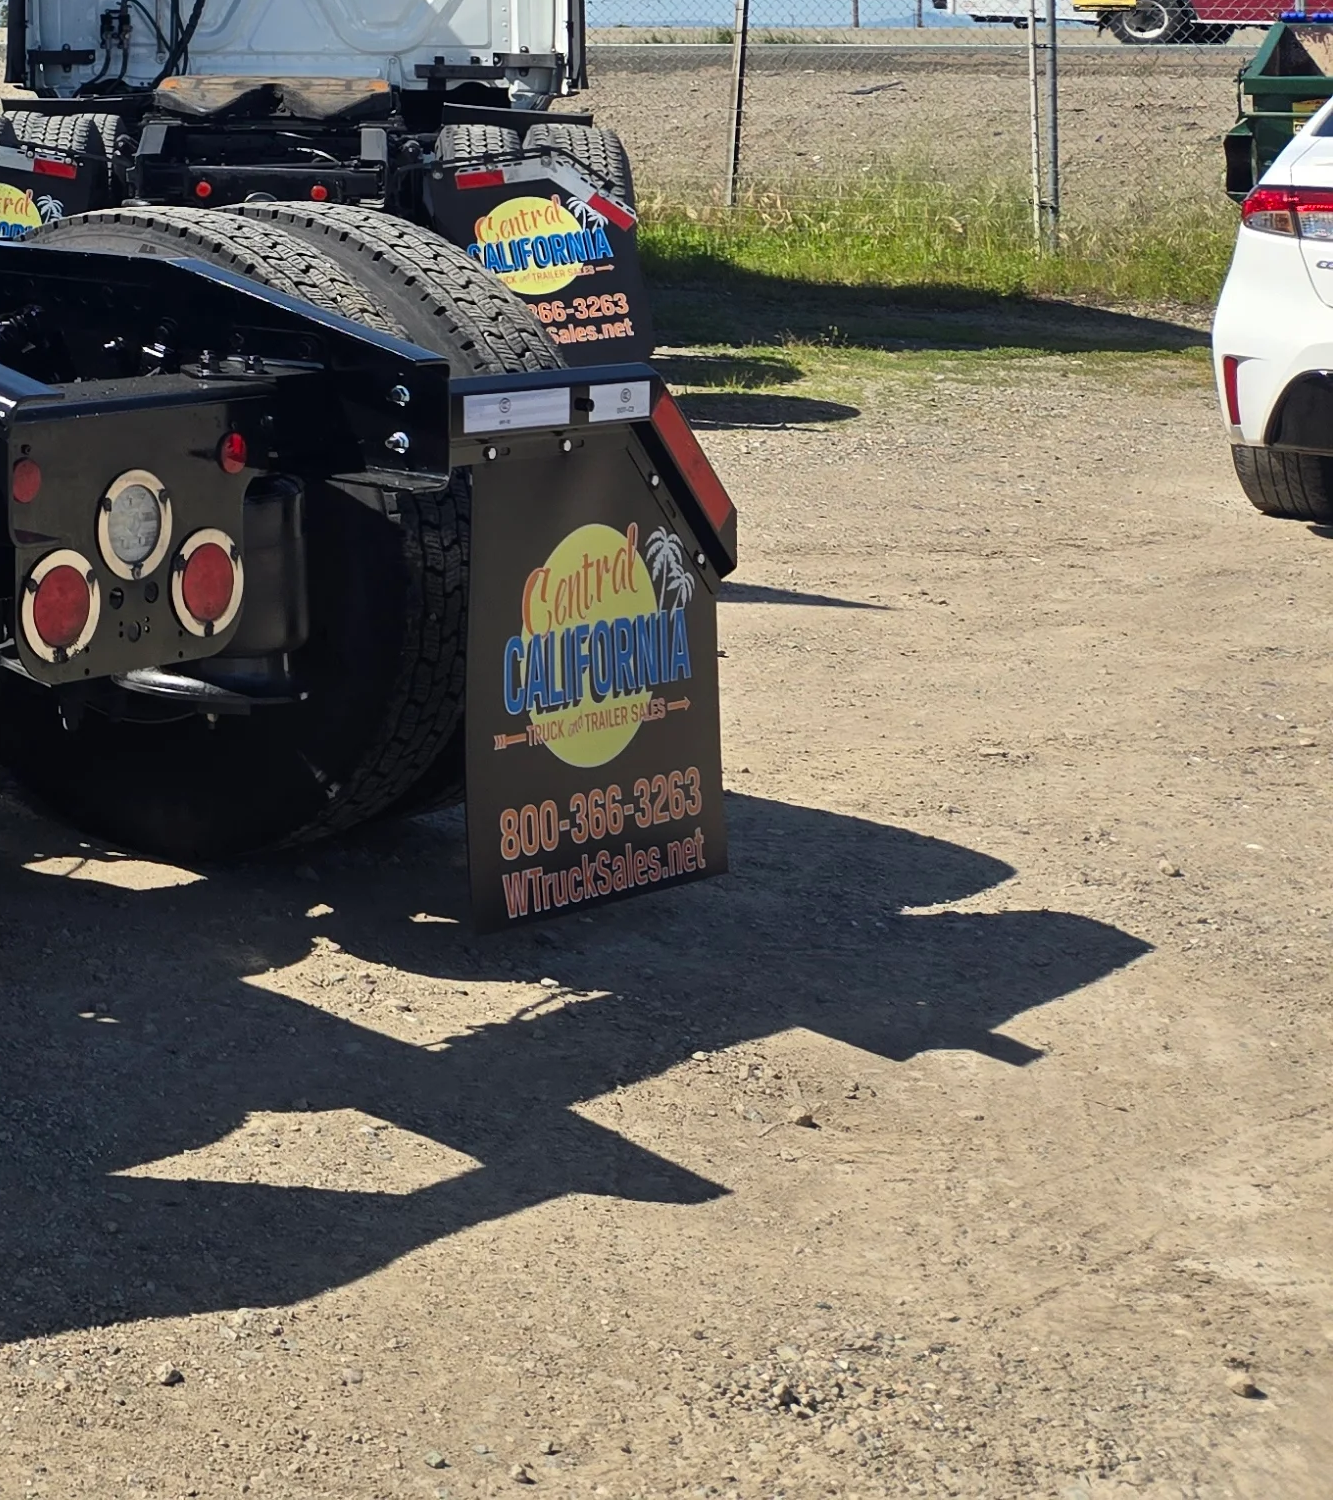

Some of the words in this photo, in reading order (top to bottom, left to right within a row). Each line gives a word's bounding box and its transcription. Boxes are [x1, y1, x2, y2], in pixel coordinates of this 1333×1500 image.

[475, 194, 564, 244] Central
[467, 227, 614, 273] CALIFORNIA
[532, 269, 566, 282] TRAILER
[567, 264, 595, 277] SALES
[546, 317, 635, 345] Sales.net
[522, 522, 640, 639] Central
[504, 606, 692, 716] CALIFORNIA
[526, 717, 565, 747] TRUCK
[585, 708, 629, 733] TRAILER
[630, 697, 666, 722] SALES
[500, 766, 703, 861] 800-366-3263
[502, 826, 707, 920] WTruckSales.net
